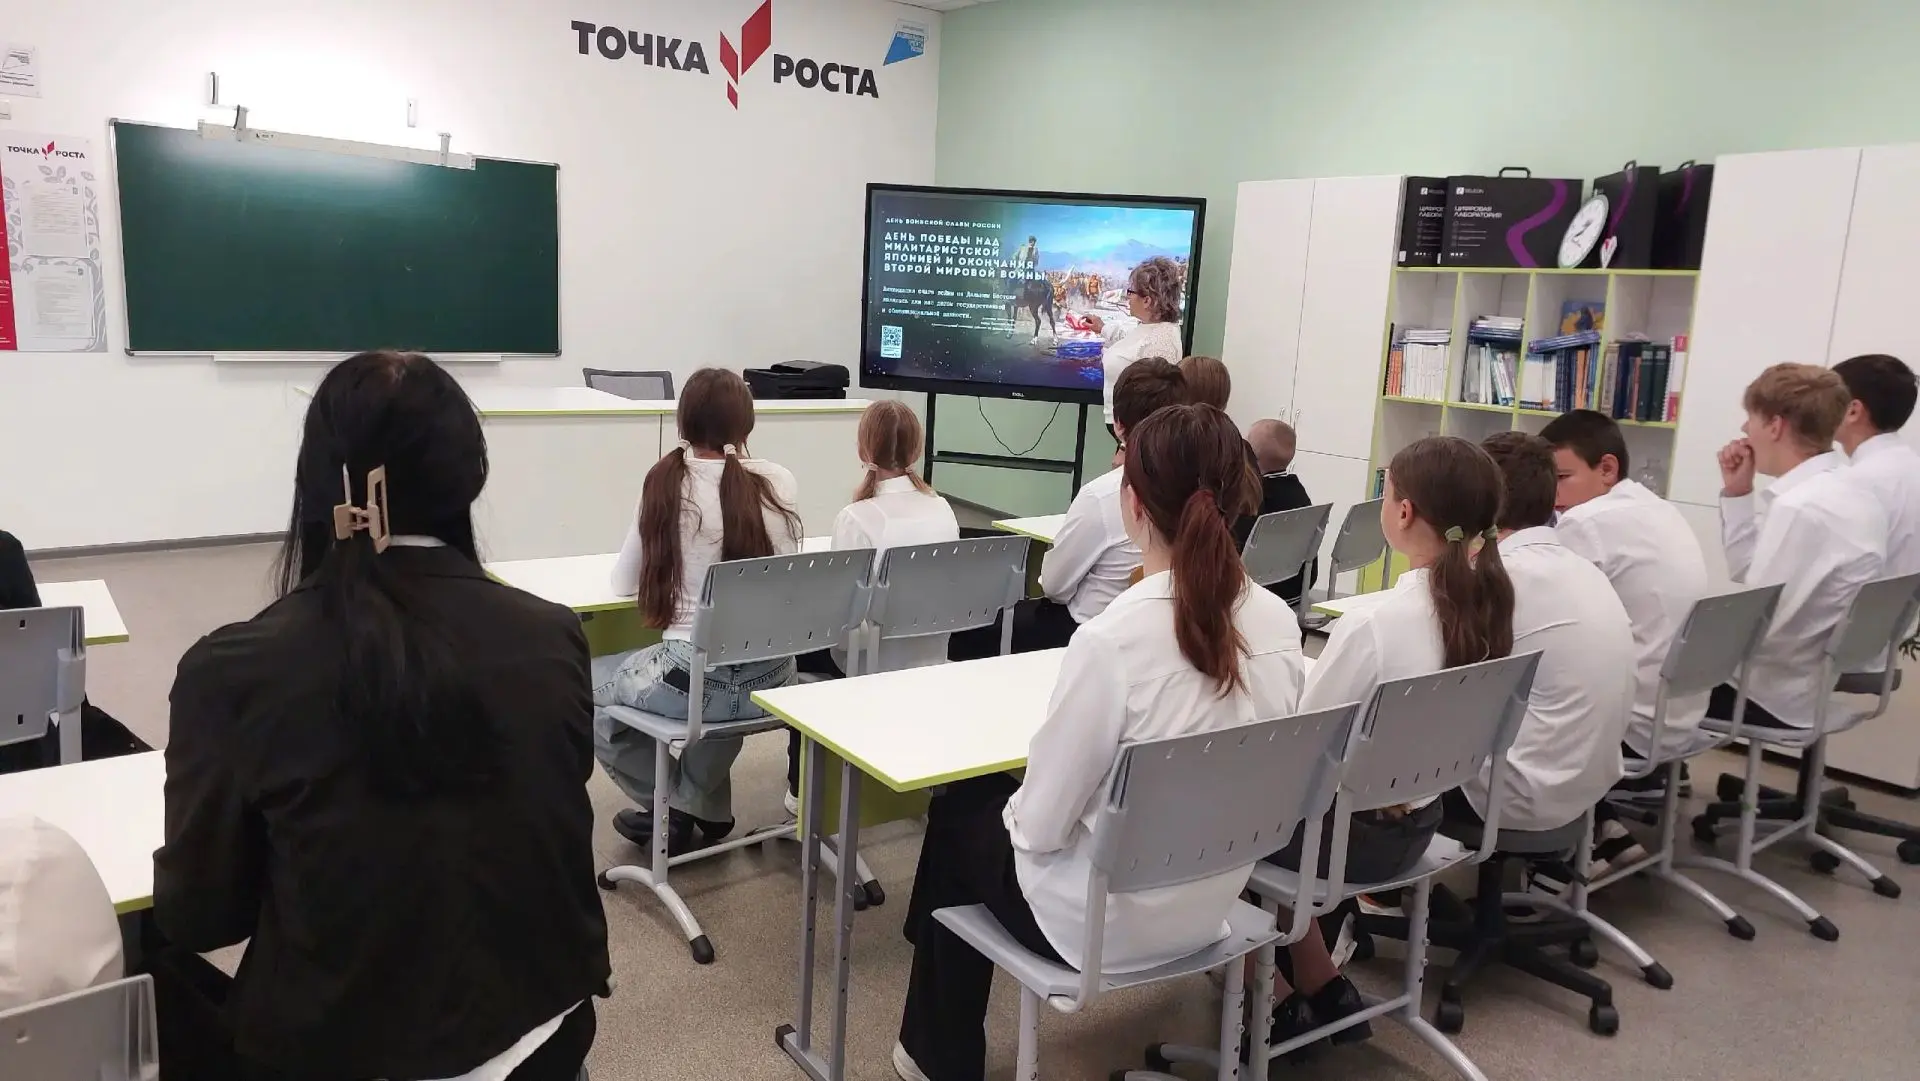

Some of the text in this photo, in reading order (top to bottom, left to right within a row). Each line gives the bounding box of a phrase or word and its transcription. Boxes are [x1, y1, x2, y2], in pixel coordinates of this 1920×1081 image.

[571, 20, 879, 98] ТОЧКА РОСТА
[7, 145, 85, 159] ТОЧКА РОСТА
[945, 220, 970, 228] СЛАВЫ
[884, 231, 1000, 247] ДЕНЬ ПОБЕДЫ НАД
[884, 242, 1000, 257] МИЛИТАРИСТСКОЙ
[884, 253, 1034, 270] ЯПОНИЕЙ И ОКОНЧАНИЯ
[884, 263, 1045, 281] ВТОРОЙ МИРОВОЙ ВОЙНЫ
